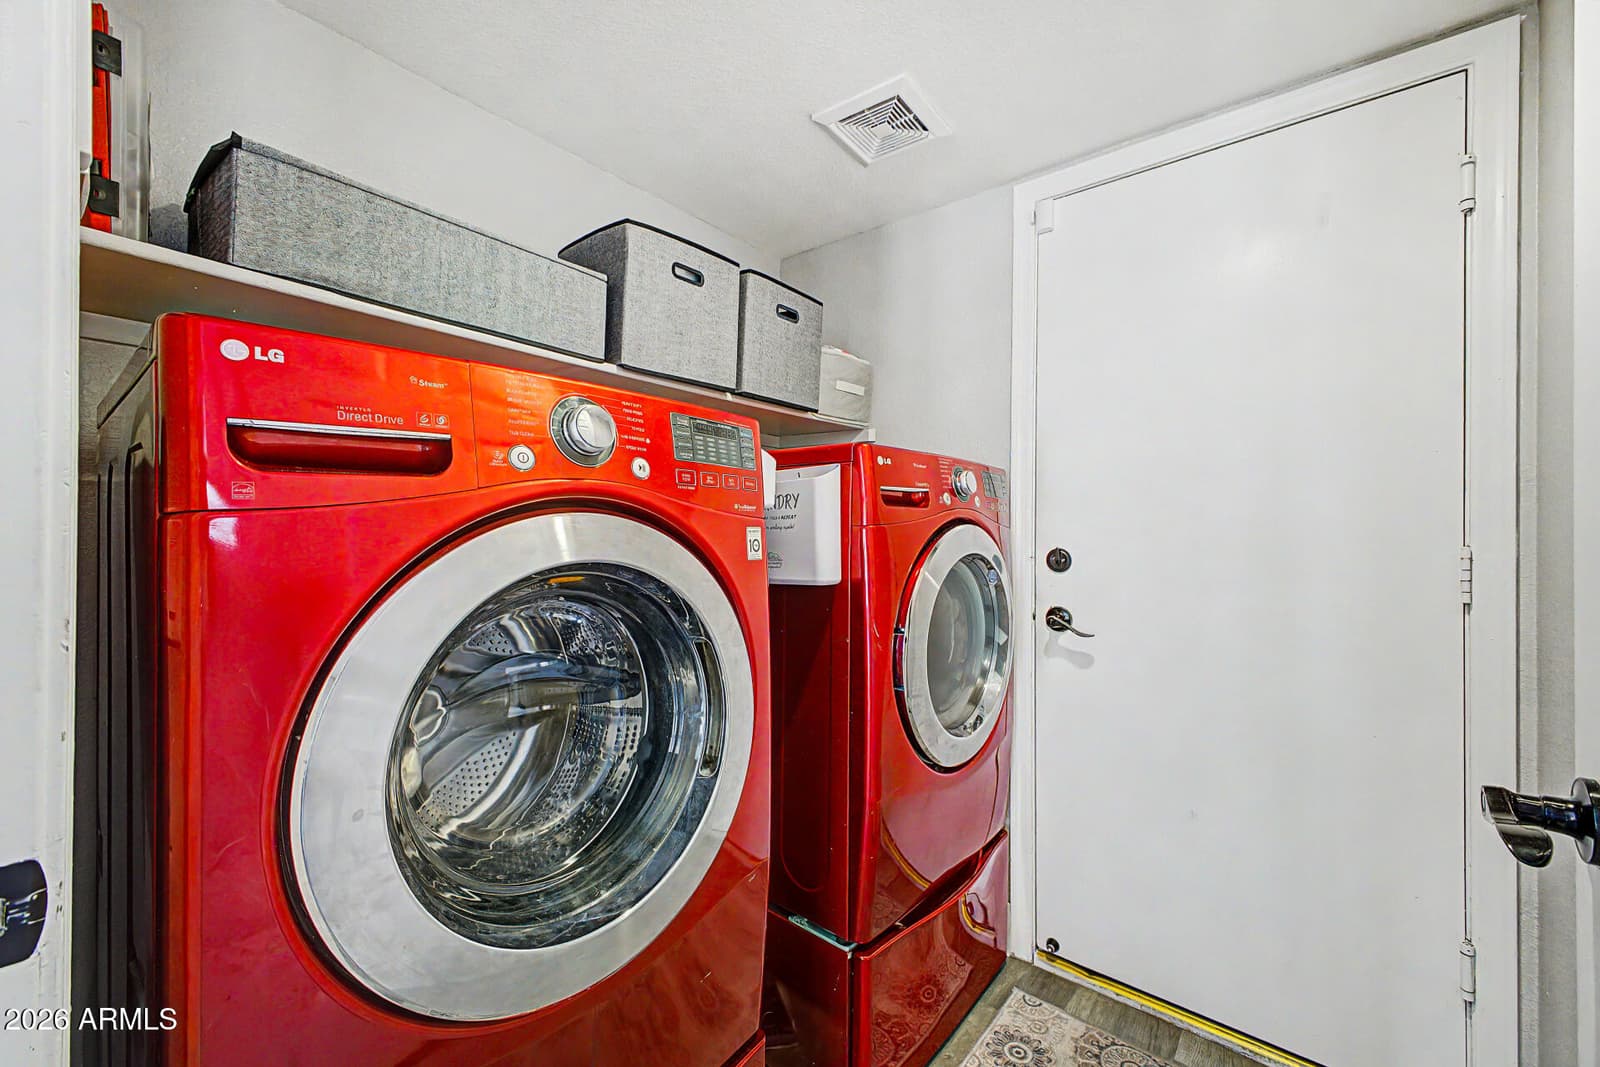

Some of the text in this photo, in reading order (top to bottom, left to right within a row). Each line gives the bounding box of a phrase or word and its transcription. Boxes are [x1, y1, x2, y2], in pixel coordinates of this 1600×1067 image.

[254, 346, 285, 363] LG
[337, 410, 404, 425] Direct Drive
